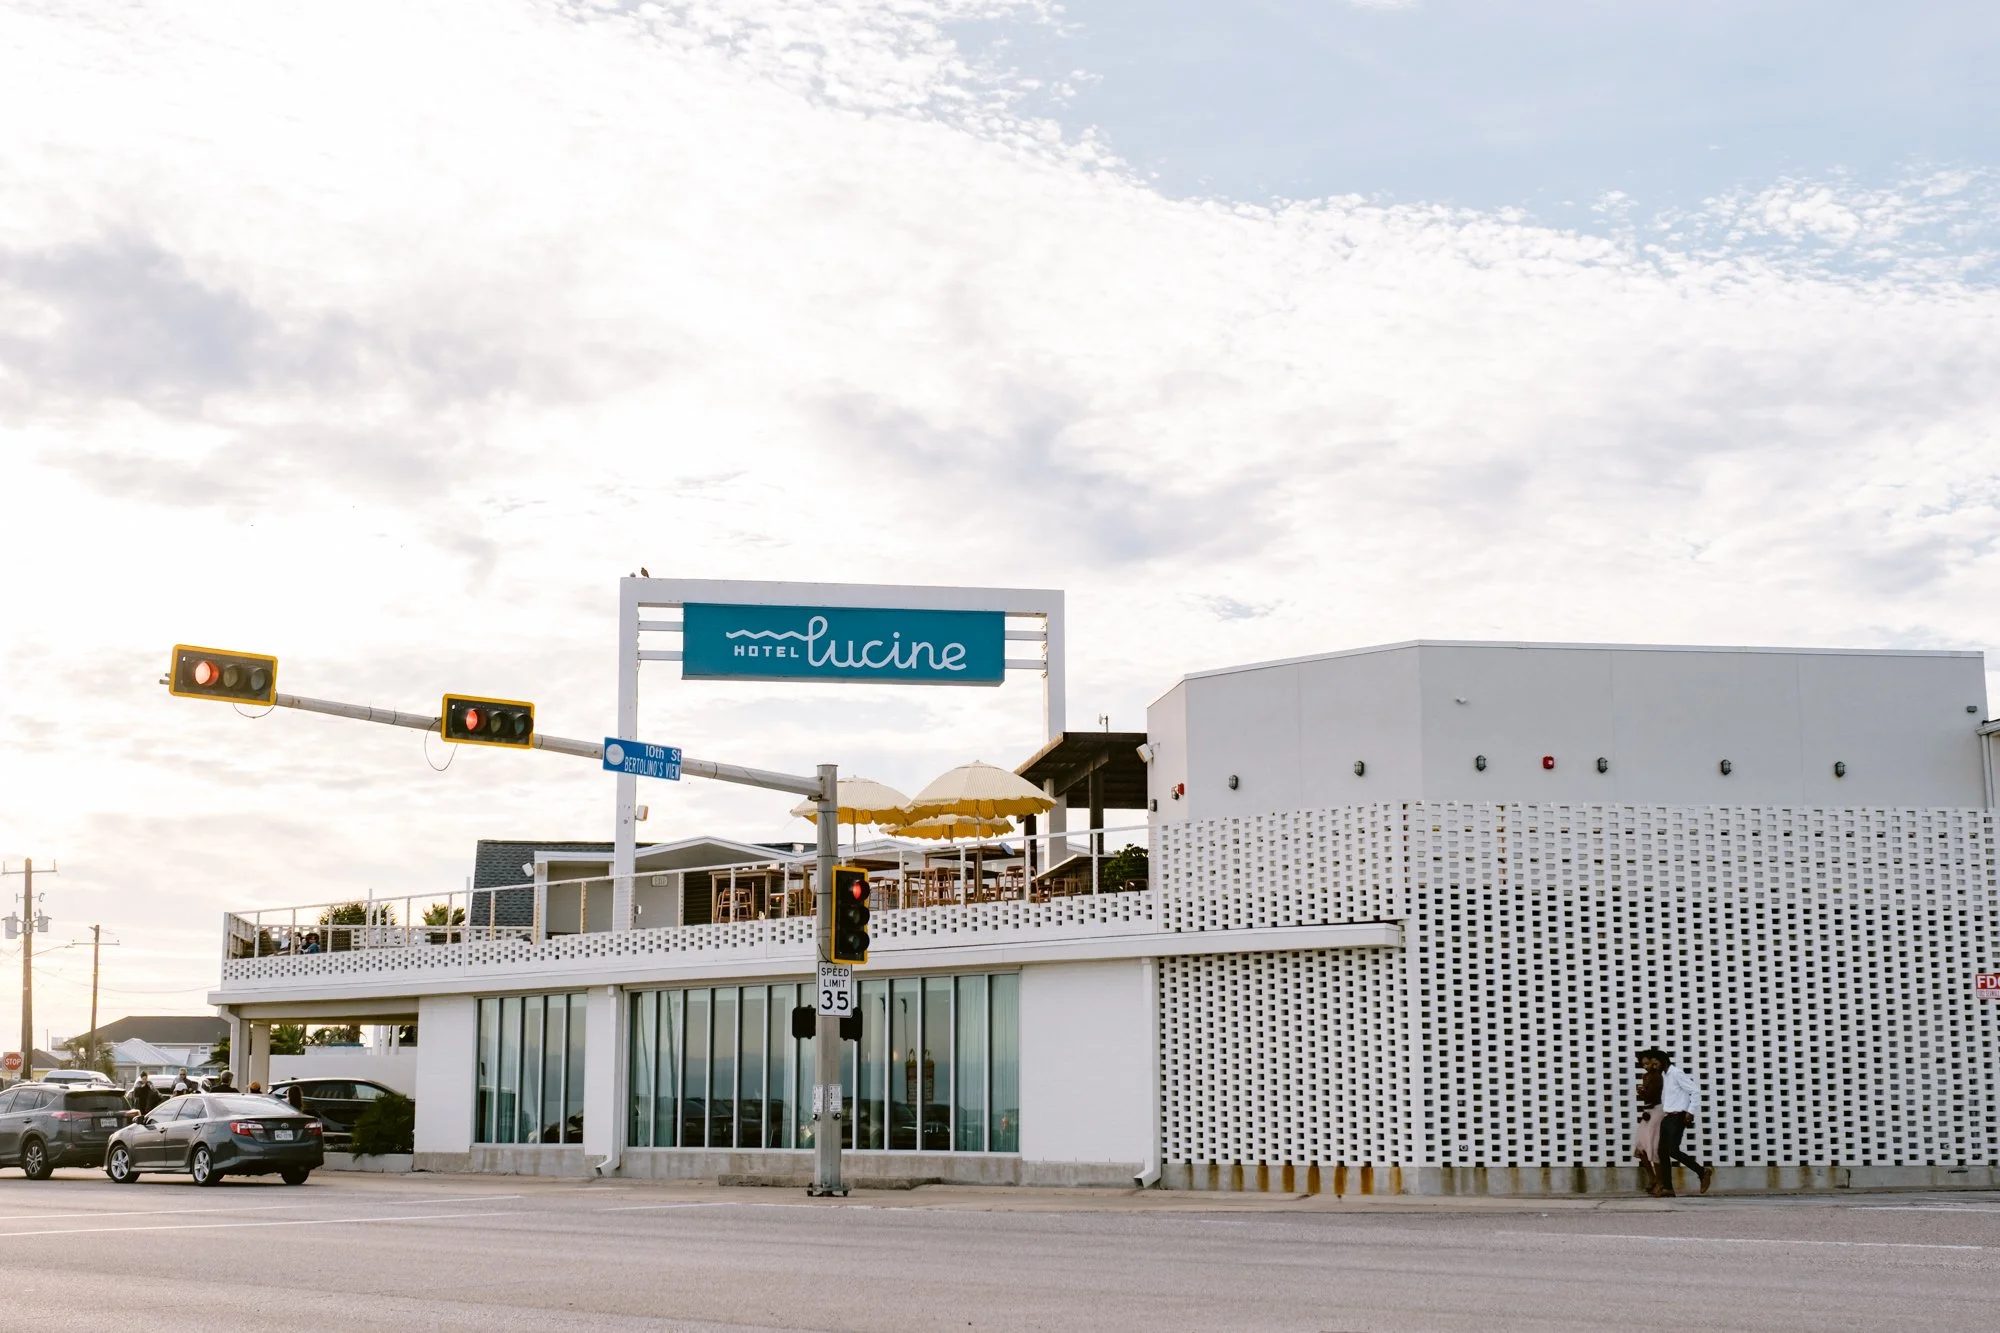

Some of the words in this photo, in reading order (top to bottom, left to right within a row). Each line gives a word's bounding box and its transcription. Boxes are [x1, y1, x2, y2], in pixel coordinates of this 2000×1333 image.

[734, 645, 799, 658] HOTEL
[807, 615, 967, 671] lucine
[645, 745, 665, 759] 10th
[671, 749, 681, 762] St
[624, 756, 664, 777] BERTOLINO'S
[665, 763, 681, 780] VIEW
[821, 966, 850, 977] SPEED
[823, 978, 846, 988] LIMIT
[1976, 975, 2000, 989] FD
[821, 989, 849, 1011] 35
[5, 1058, 22, 1066] STOP
